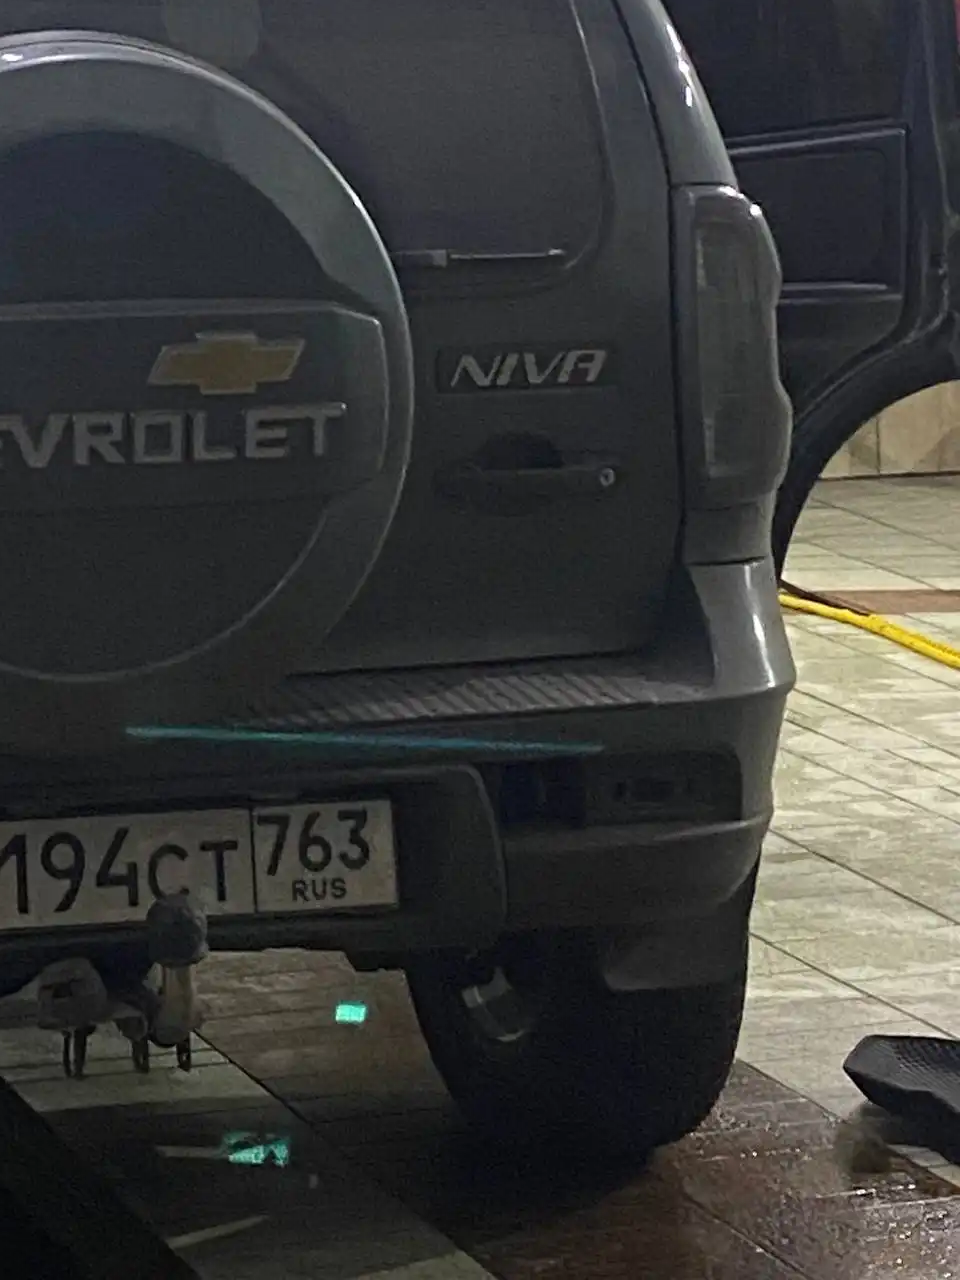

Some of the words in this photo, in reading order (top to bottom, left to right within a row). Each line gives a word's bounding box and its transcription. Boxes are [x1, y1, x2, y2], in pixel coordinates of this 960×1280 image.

[451, 349, 607, 388] NIVA
[256, 809, 370, 876] 763
[292, 877, 347, 902] RUS
